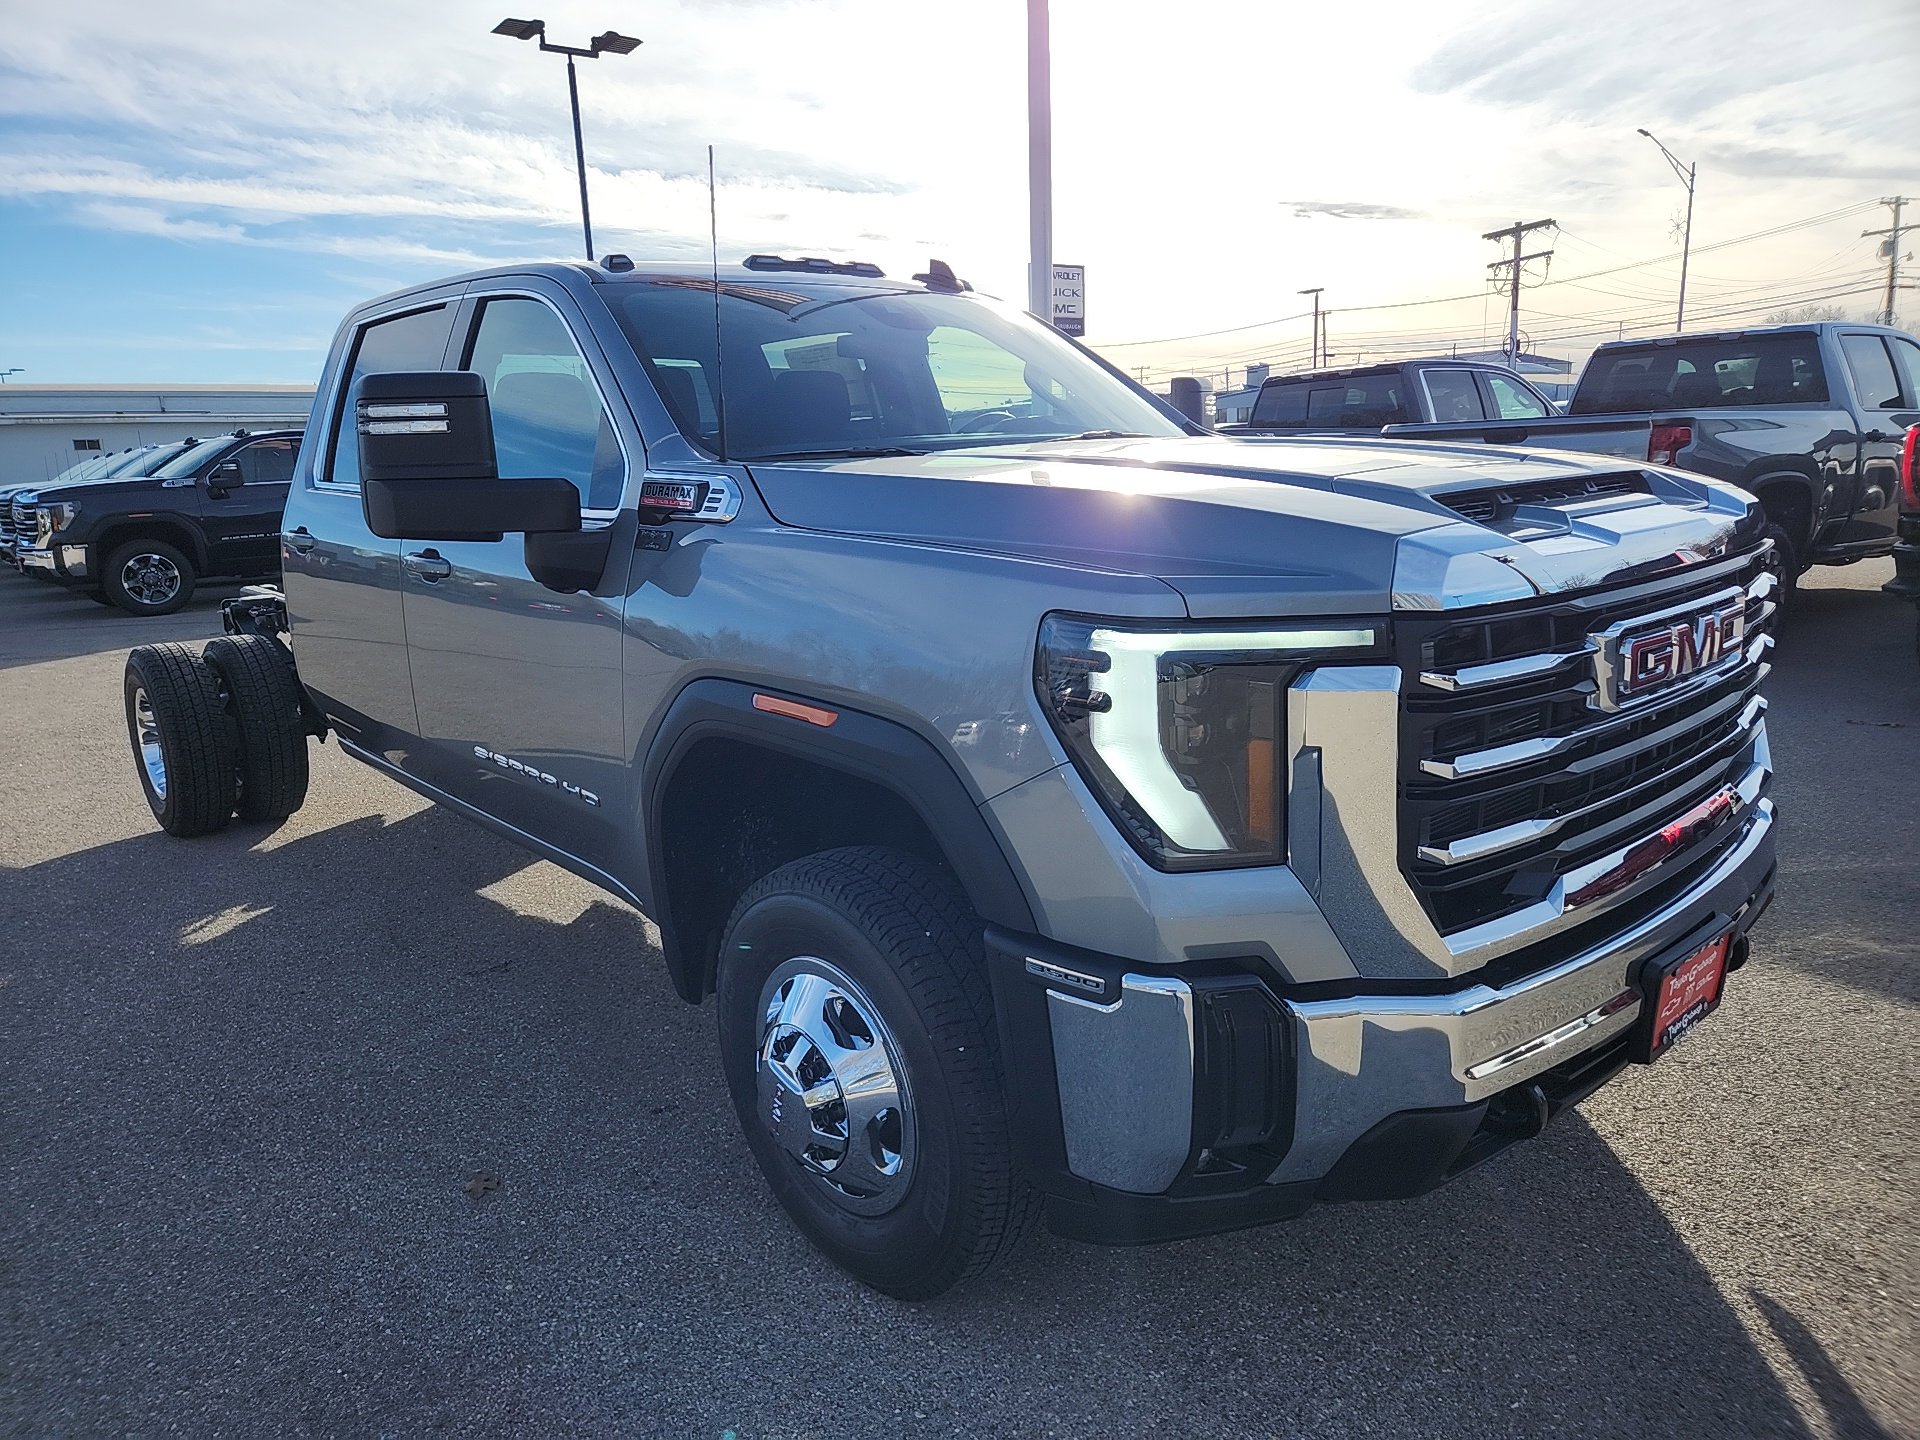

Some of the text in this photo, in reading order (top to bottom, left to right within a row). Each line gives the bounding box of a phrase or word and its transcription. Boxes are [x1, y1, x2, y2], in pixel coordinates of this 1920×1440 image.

[1053, 271, 1080, 280] VROLET
[1053, 288, 1081, 298] UICK
[1053, 304, 1076, 314] MC
[645, 484, 693, 499] DURAMAX
[1622, 604, 1744, 692] GMC
[473, 745, 559, 788] SIERRA
